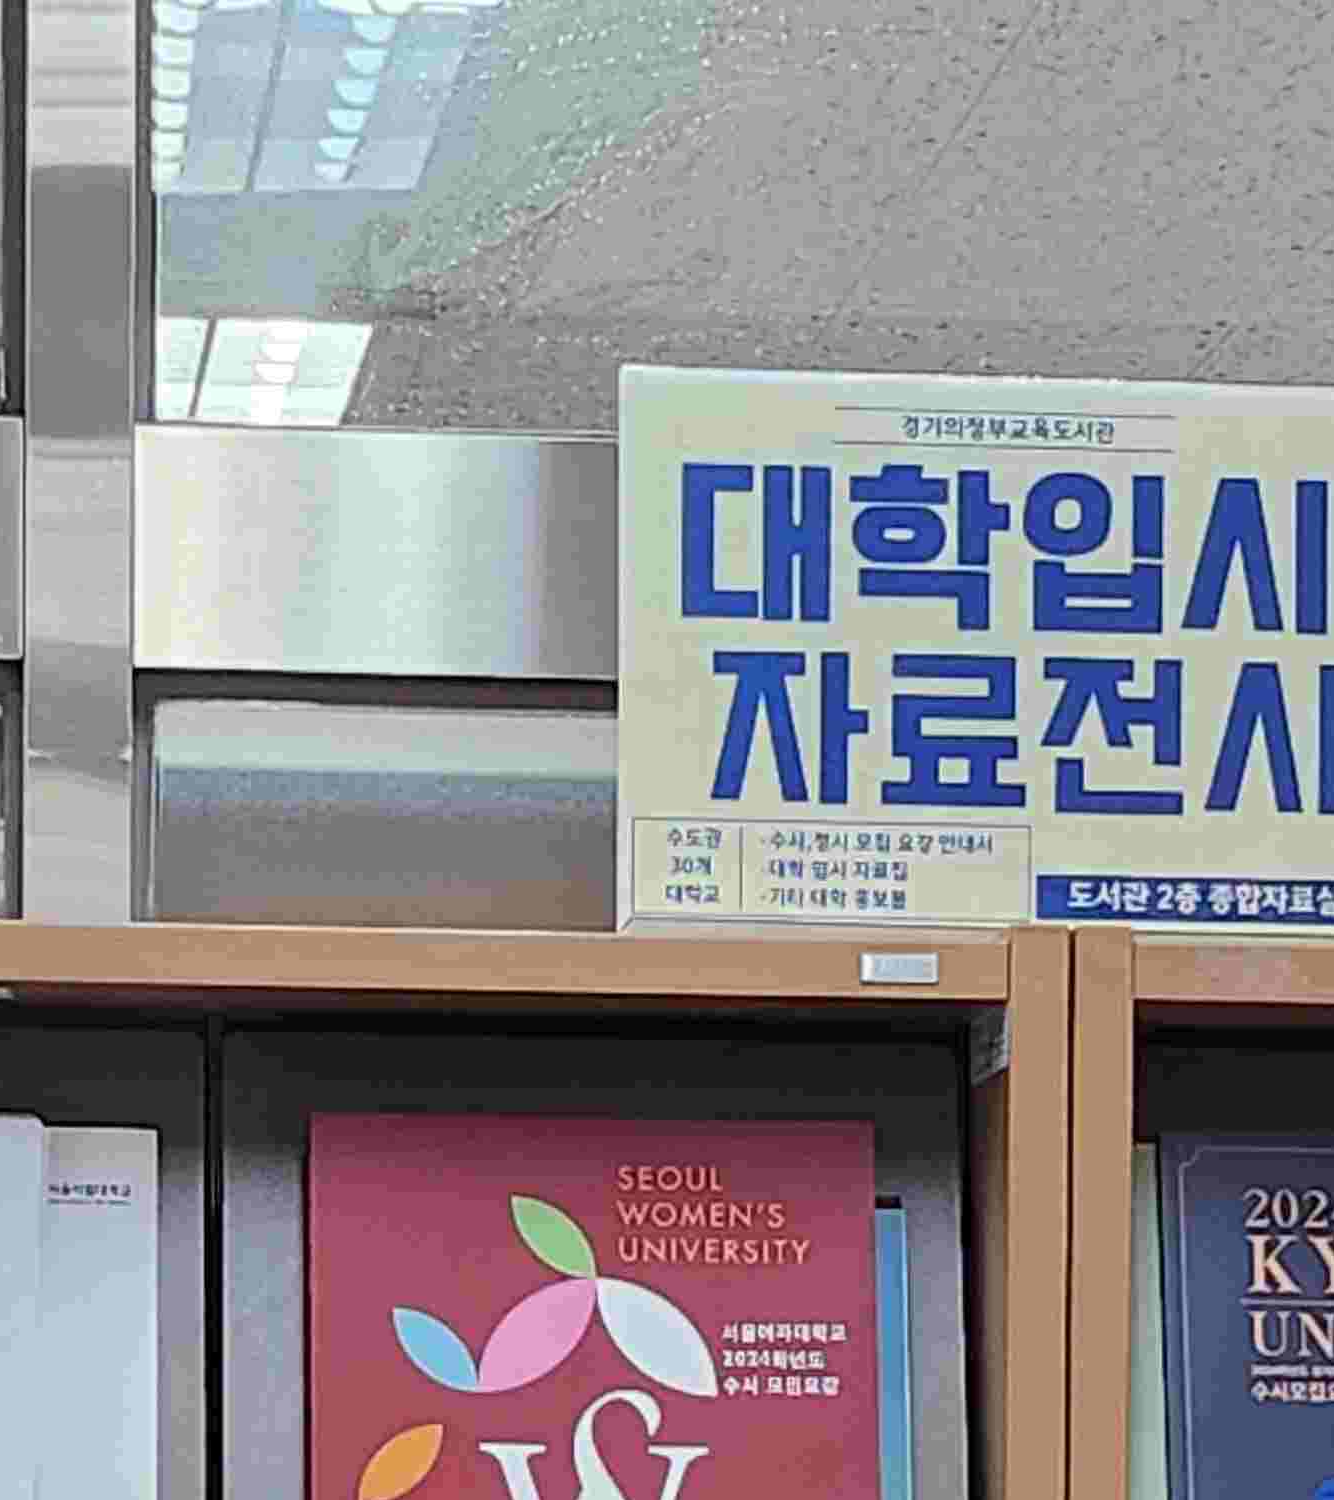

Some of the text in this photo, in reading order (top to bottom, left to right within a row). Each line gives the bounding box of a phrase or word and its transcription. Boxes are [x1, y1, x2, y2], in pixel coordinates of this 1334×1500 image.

[681, 463, 1328, 635] 대학입시
[1066, 880, 1150, 914] 도서관
[1155, 881, 1200, 915] 2층
[617, 1165, 724, 1192] SEOUL
[616, 1200, 786, 1230] WOMEN'S
[617, 1235, 811, 1265] UNIVERSITY
